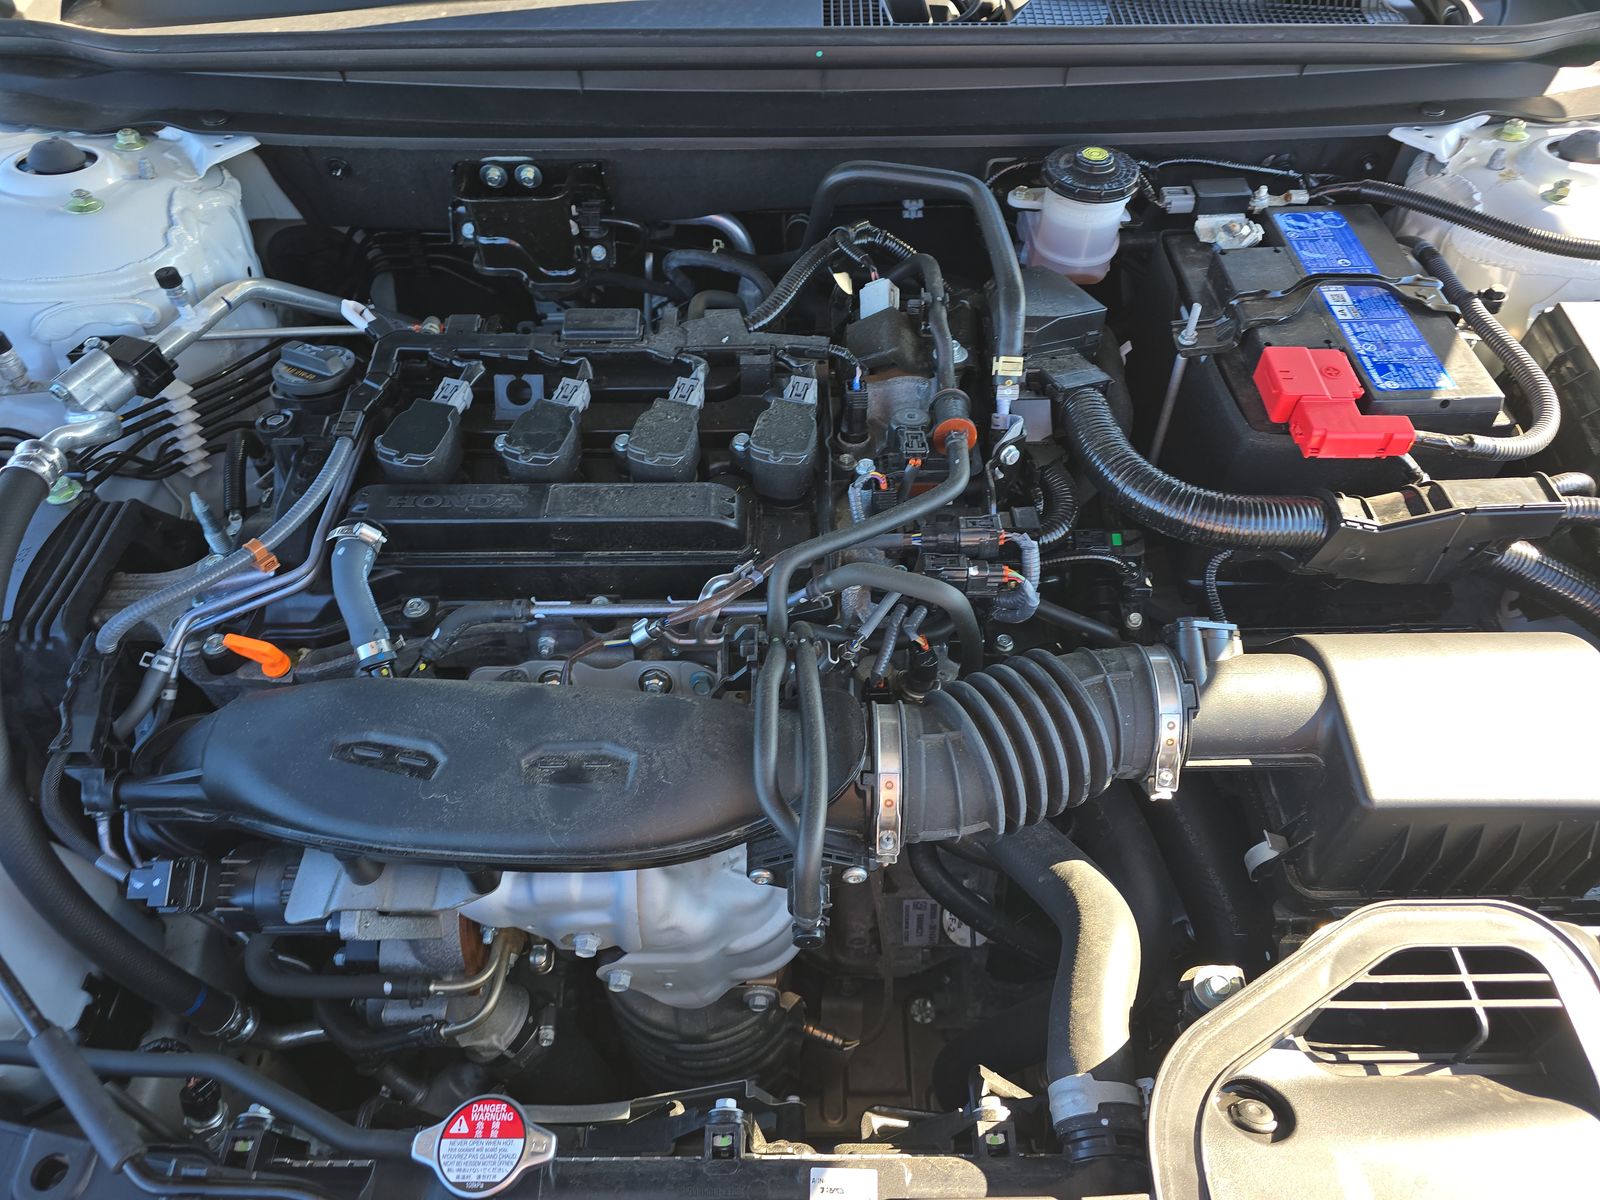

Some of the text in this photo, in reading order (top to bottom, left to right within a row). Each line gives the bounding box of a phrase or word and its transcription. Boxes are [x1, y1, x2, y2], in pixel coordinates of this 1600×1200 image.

[386, 493, 524, 509] HONDA
[472, 1104, 507, 1112] DANGER
[471, 1112, 514, 1121] WARNUNG
